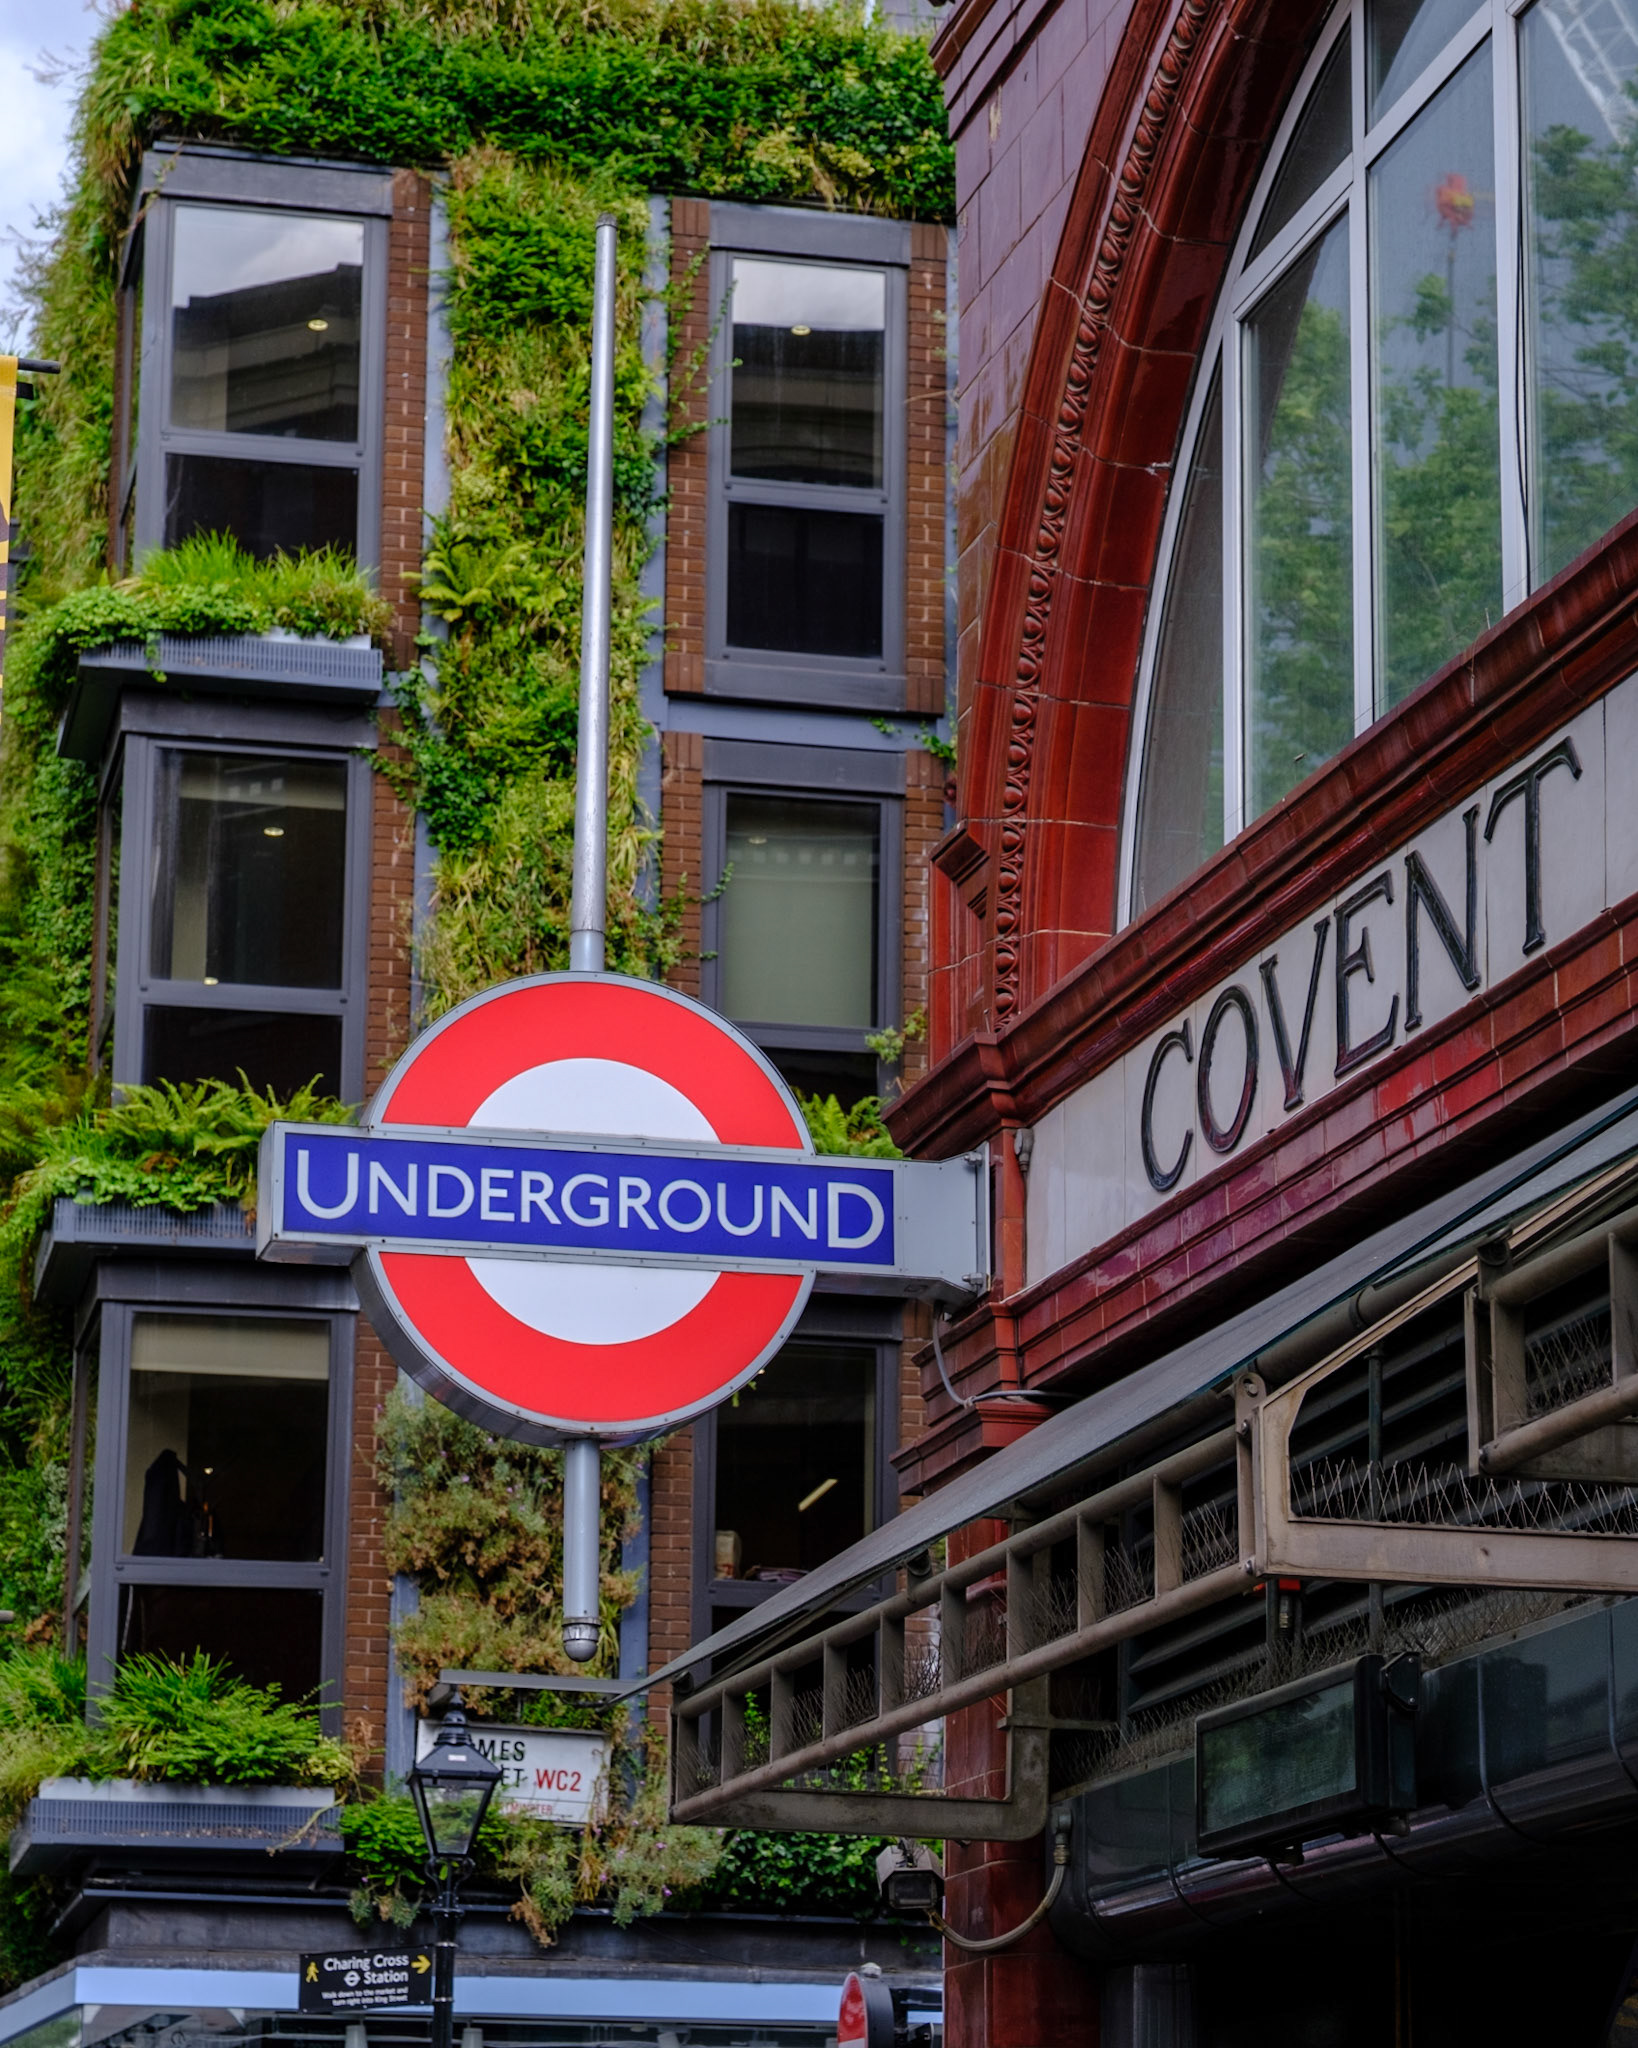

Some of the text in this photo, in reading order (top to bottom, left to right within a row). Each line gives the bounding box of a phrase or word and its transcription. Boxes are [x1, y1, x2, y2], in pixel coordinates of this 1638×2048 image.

[1141, 735, 1583, 1192] COVENT
[296, 1148, 885, 1249] UNDERGROUND
[477, 1738, 526, 1762] MES
[535, 1767, 582, 1792] WC2
[323, 1954, 409, 1971] Charing Cross
[363, 1971, 409, 1985] Station
[321, 1991, 337, 1999] Walk
[338, 1990, 354, 1998] down
[375, 1987, 396, 1995] market
[397, 1986, 408, 1994] and
[374, 1996, 388, 2004] King
[388, 1994, 408, 2002] Street
